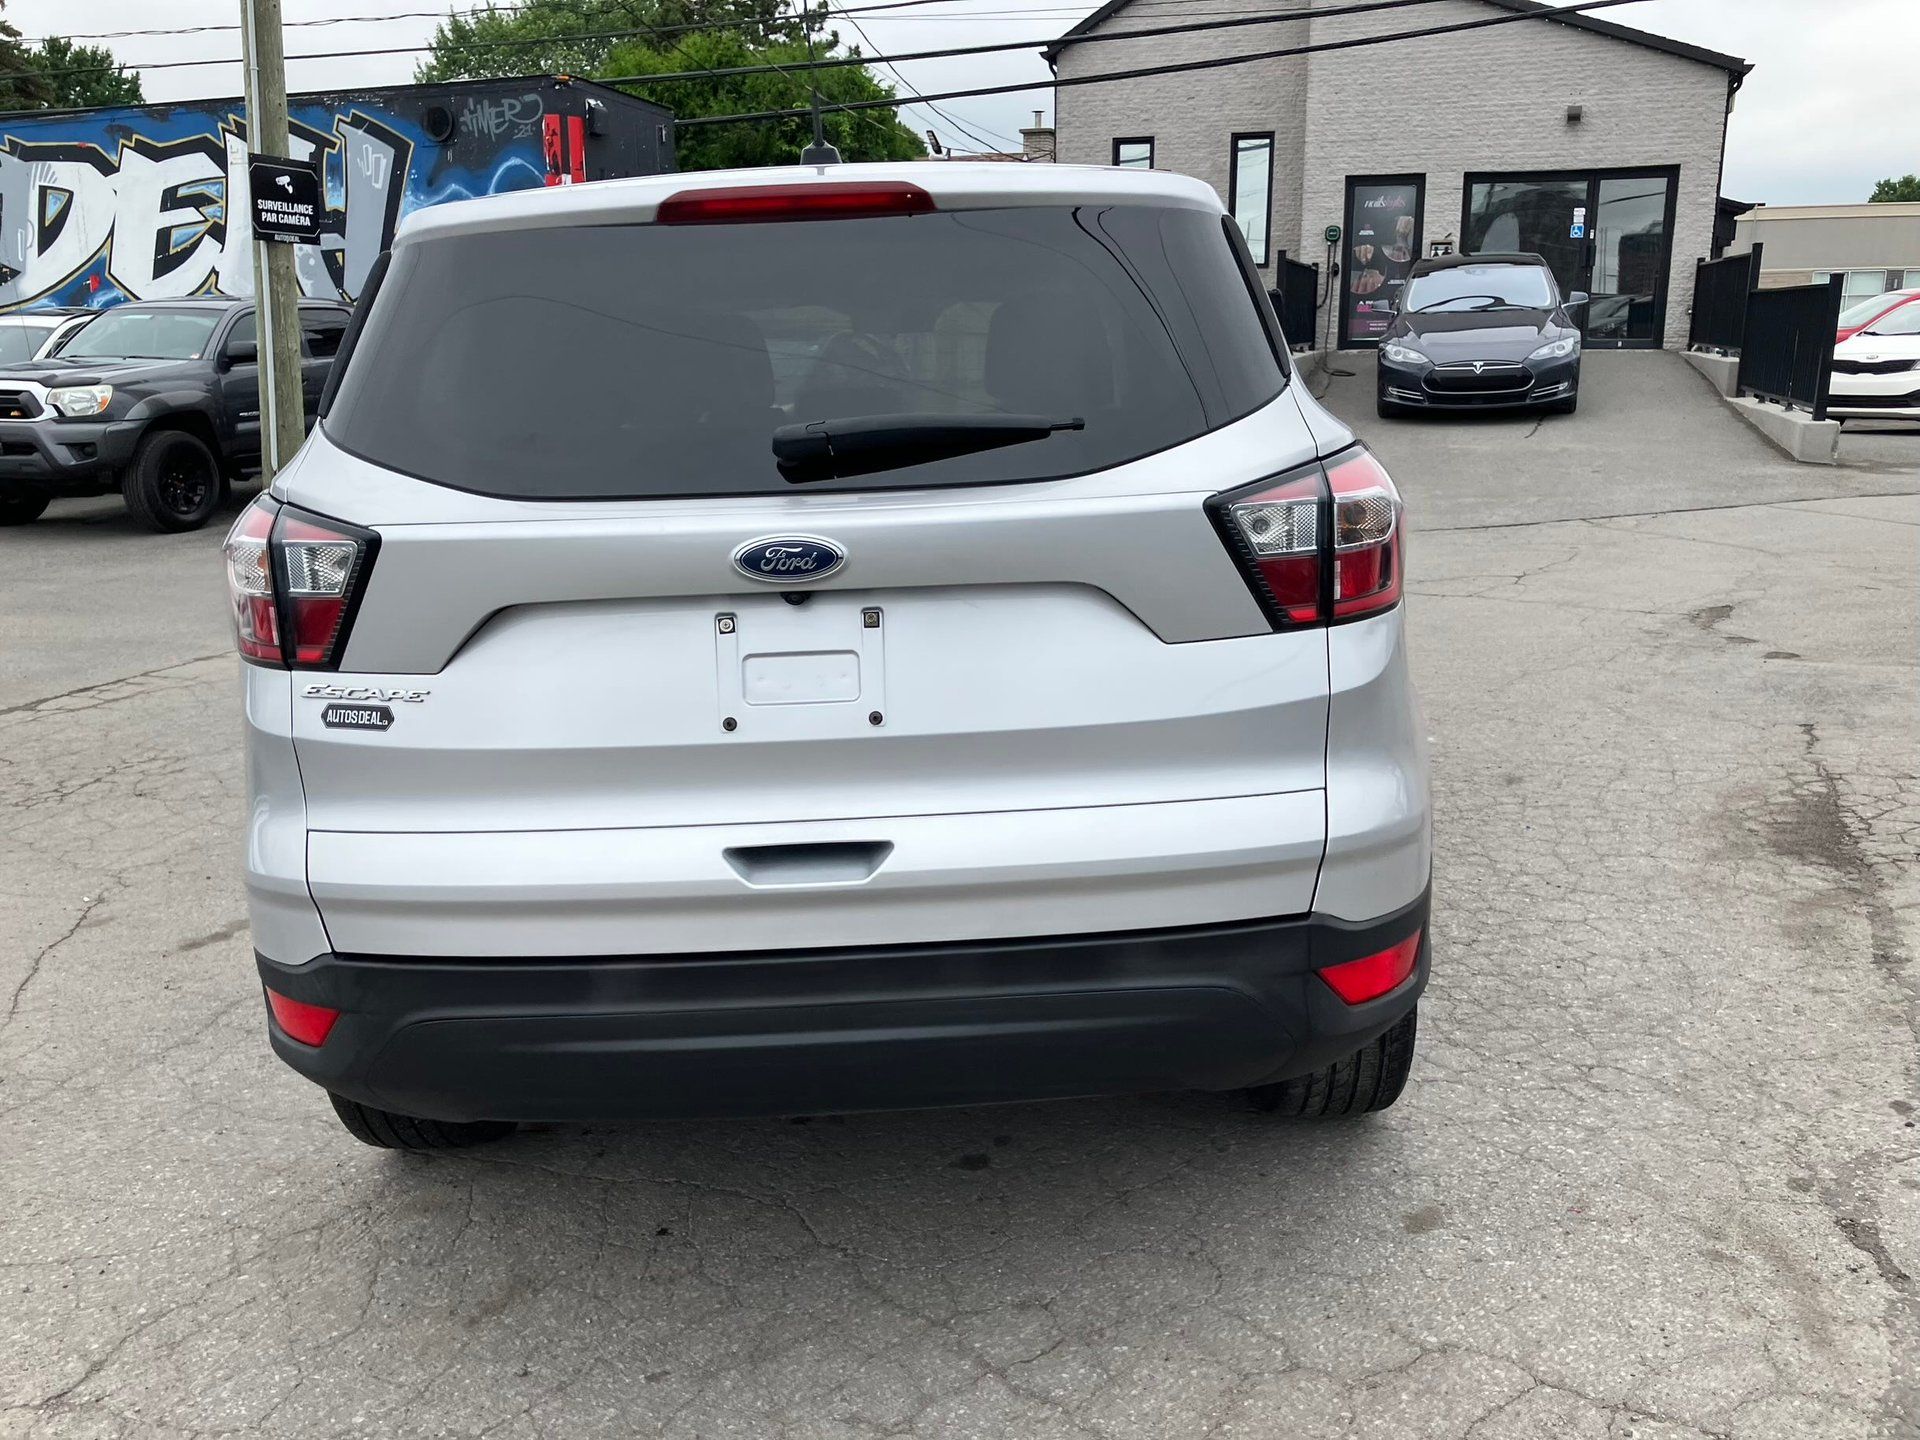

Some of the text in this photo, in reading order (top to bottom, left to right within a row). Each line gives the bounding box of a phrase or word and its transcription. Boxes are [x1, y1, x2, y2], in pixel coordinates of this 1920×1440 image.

[257, 199, 314, 215] SURVEILLANCE
[261, 212, 311, 226] PAR CAMÉRA
[760, 546, 818, 572] Ford
[301, 683, 432, 703] ESCAPE
